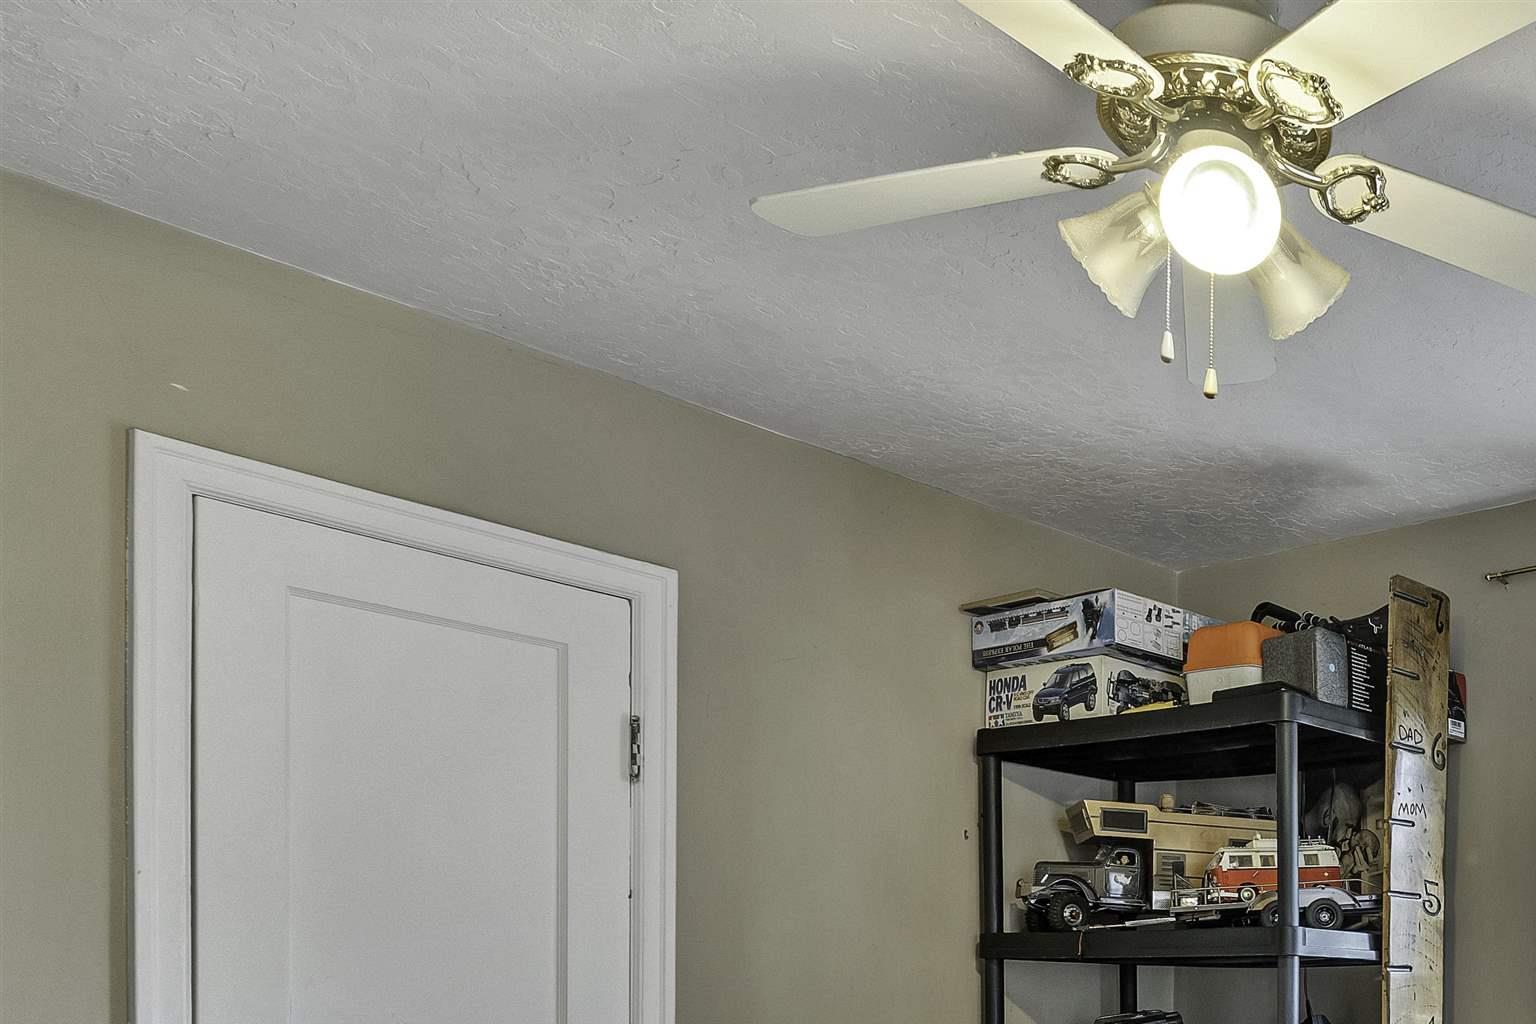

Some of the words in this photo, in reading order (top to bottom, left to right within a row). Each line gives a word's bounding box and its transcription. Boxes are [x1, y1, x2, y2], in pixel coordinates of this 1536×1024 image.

[989, 674, 1028, 697] HONDA
[1399, 724, 1424, 745] DAD
[1431, 732, 1446, 772] 6
[1398, 801, 1428, 819] MOM
[1422, 880, 1442, 917] 5
